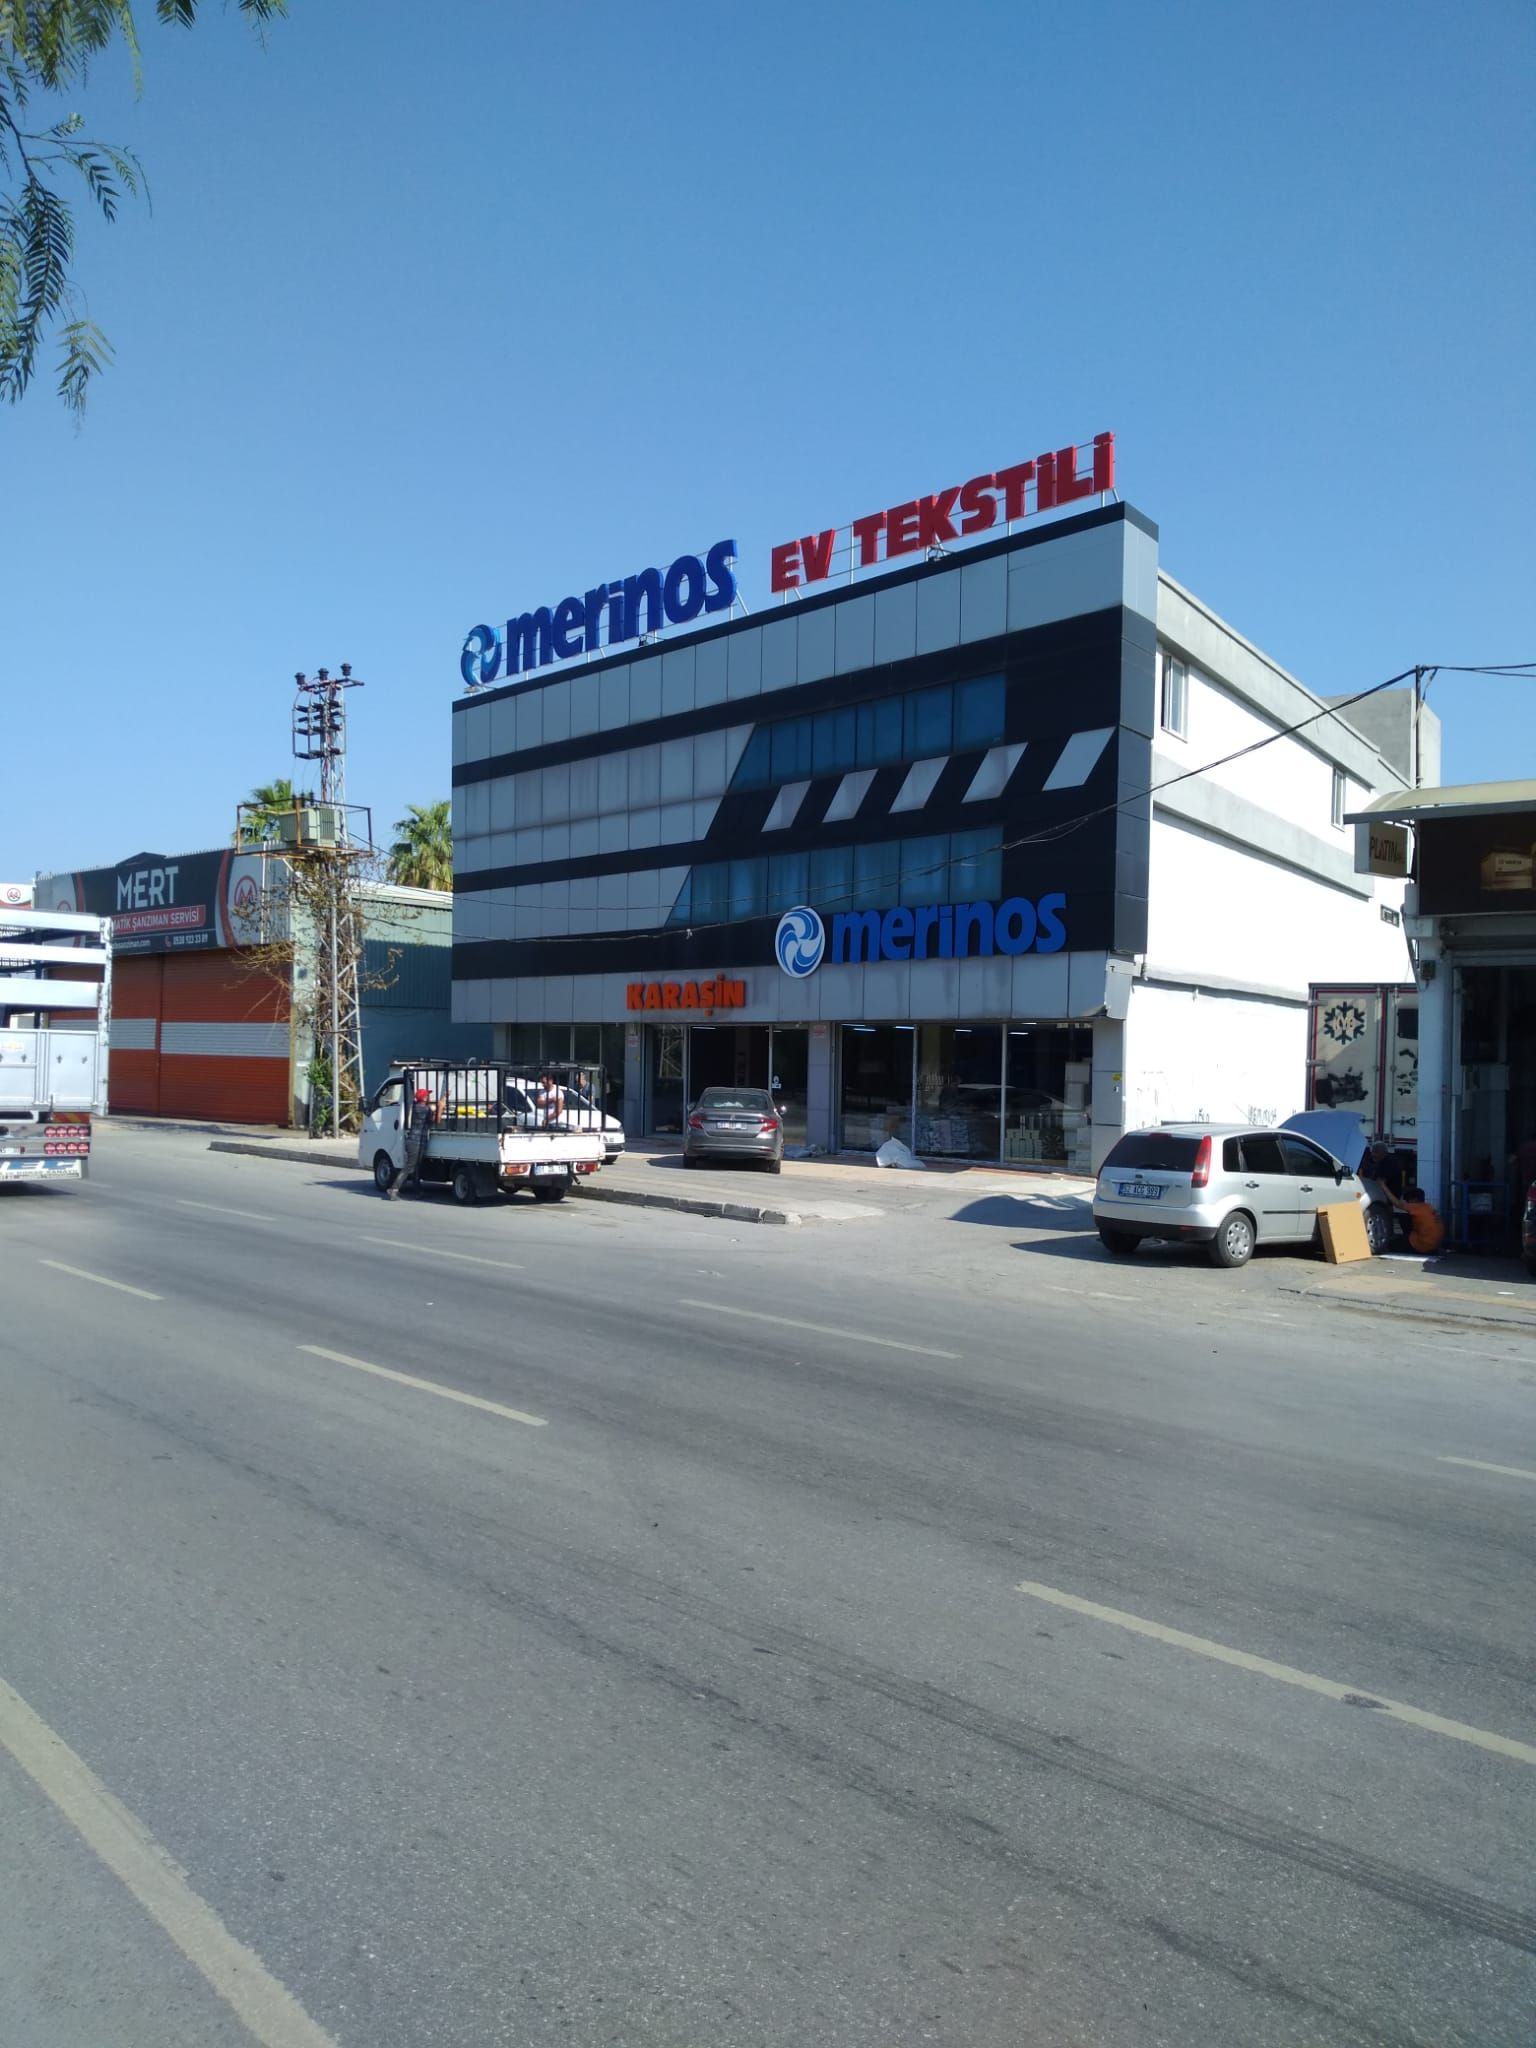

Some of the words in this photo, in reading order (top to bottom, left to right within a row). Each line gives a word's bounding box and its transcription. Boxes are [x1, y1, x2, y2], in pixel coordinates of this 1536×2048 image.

[506, 538, 738, 676] merinos
[772, 528, 836, 593] EV
[852, 431, 1115, 566] TEKSTİLİ
[117, 865, 179, 911] MERT
[170, 907, 199, 925] SERVİSİ
[831, 892, 1066, 964] merinos
[626, 974, 746, 1017] KARAŞİN
